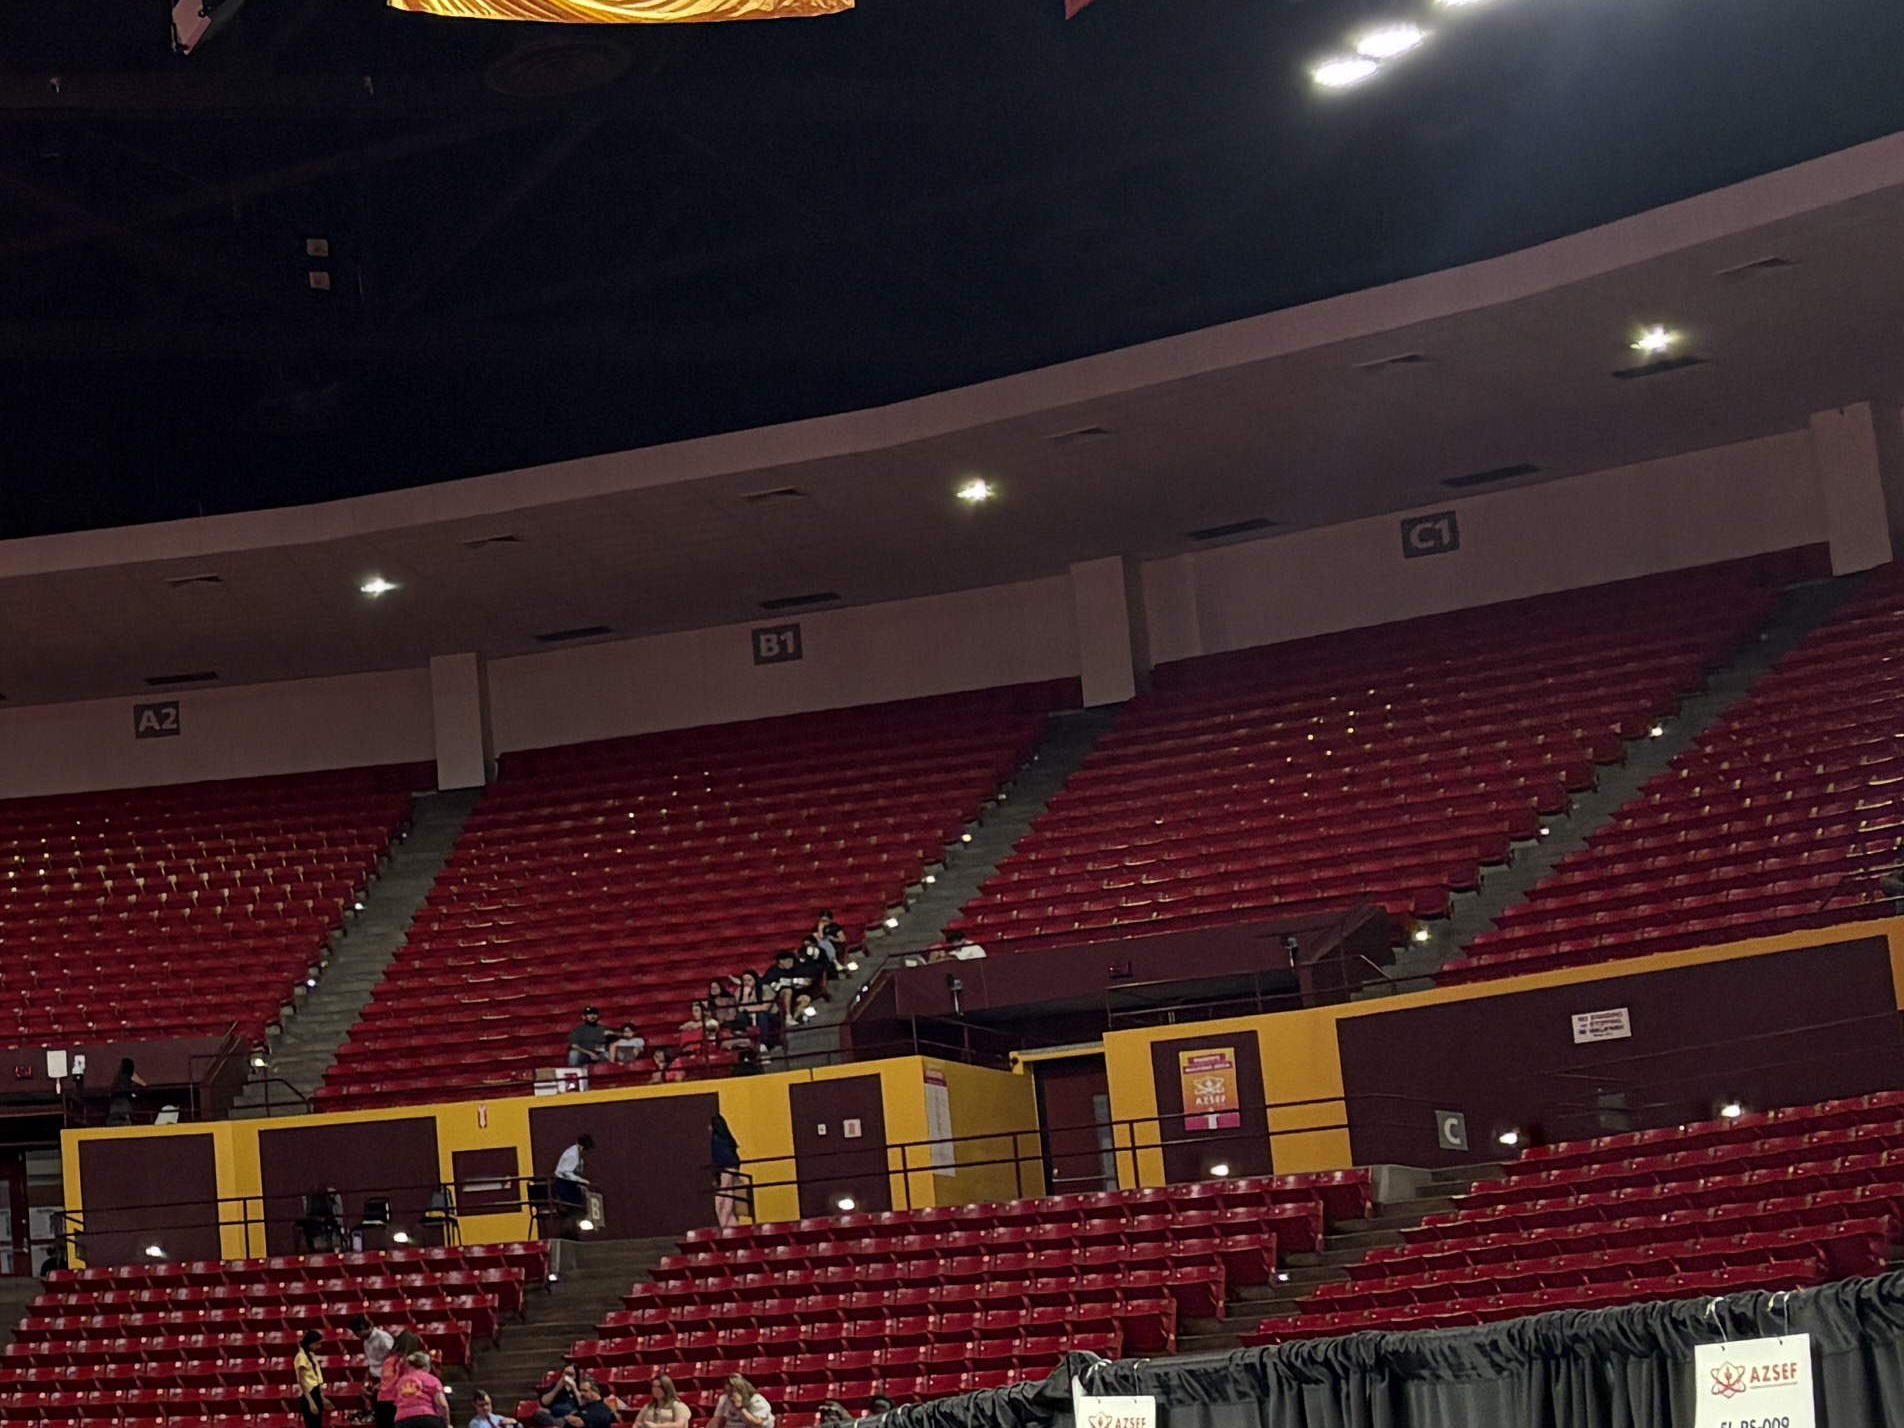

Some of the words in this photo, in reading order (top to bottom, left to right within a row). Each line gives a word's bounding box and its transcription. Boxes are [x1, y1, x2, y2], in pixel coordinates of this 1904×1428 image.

[1410, 518, 1452, 549] C1
[759, 631, 796, 657] B1
[139, 708, 178, 732] A2
[1444, 1116, 1461, 1145] C
[591, 1198, 600, 1220] B
[1750, 1363, 1798, 1383] AZSEF
